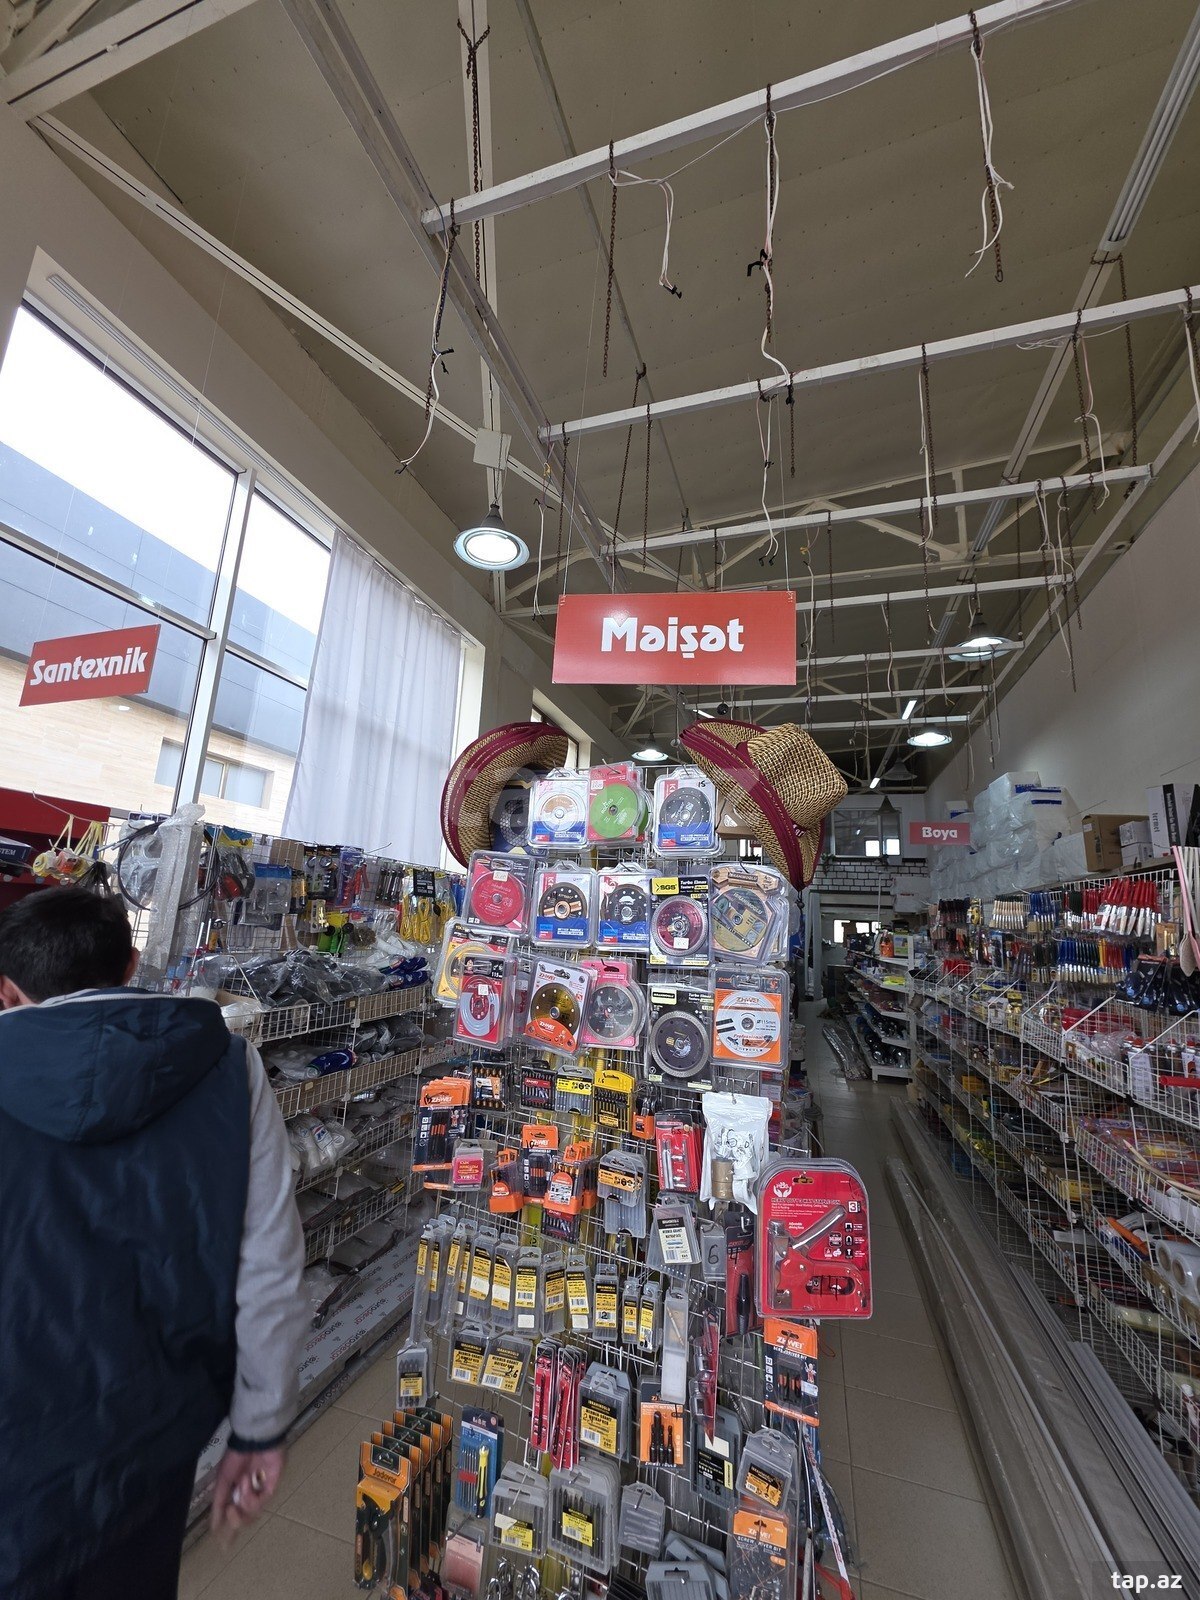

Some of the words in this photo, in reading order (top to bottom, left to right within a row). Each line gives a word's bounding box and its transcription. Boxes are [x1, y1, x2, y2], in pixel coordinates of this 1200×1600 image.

[601, 617, 744, 659] Maişat
[30, 646, 148, 686] Santexnik
[922, 826, 958, 840] Boya
[849, 1202, 857, 1211] 3
[708, 1244, 719, 1265] 6
[600, 1311, 608, 1320] 2
[373, 1467, 397, 1484] Jadever
[705, 1477, 721, 1495] 3.8
